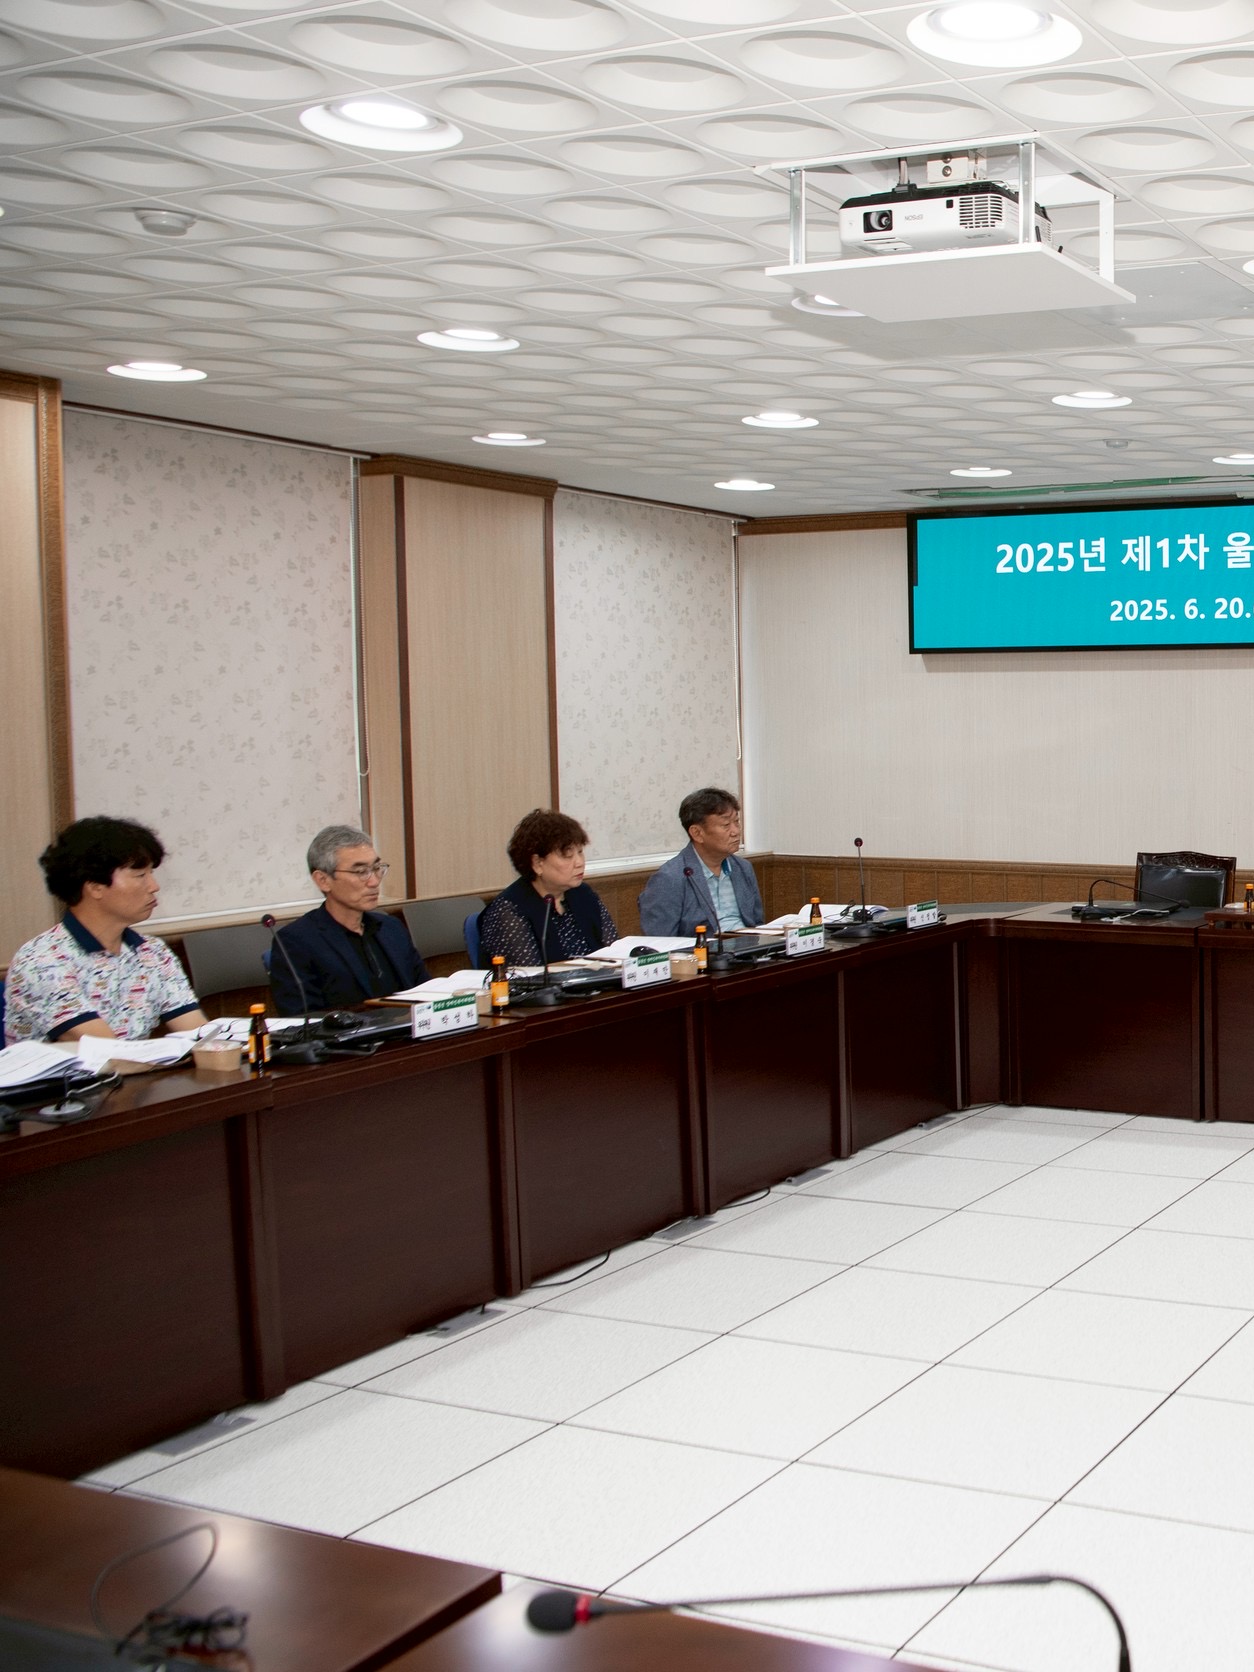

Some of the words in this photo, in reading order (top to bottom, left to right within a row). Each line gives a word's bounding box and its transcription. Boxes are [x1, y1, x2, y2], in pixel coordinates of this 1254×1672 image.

[996, 537, 1106, 574] 2025년
[1121, 533, 1210, 572] 제1차
[1110, 600, 1176, 621] 2025.
[1184, 598, 1206, 620] 6.
